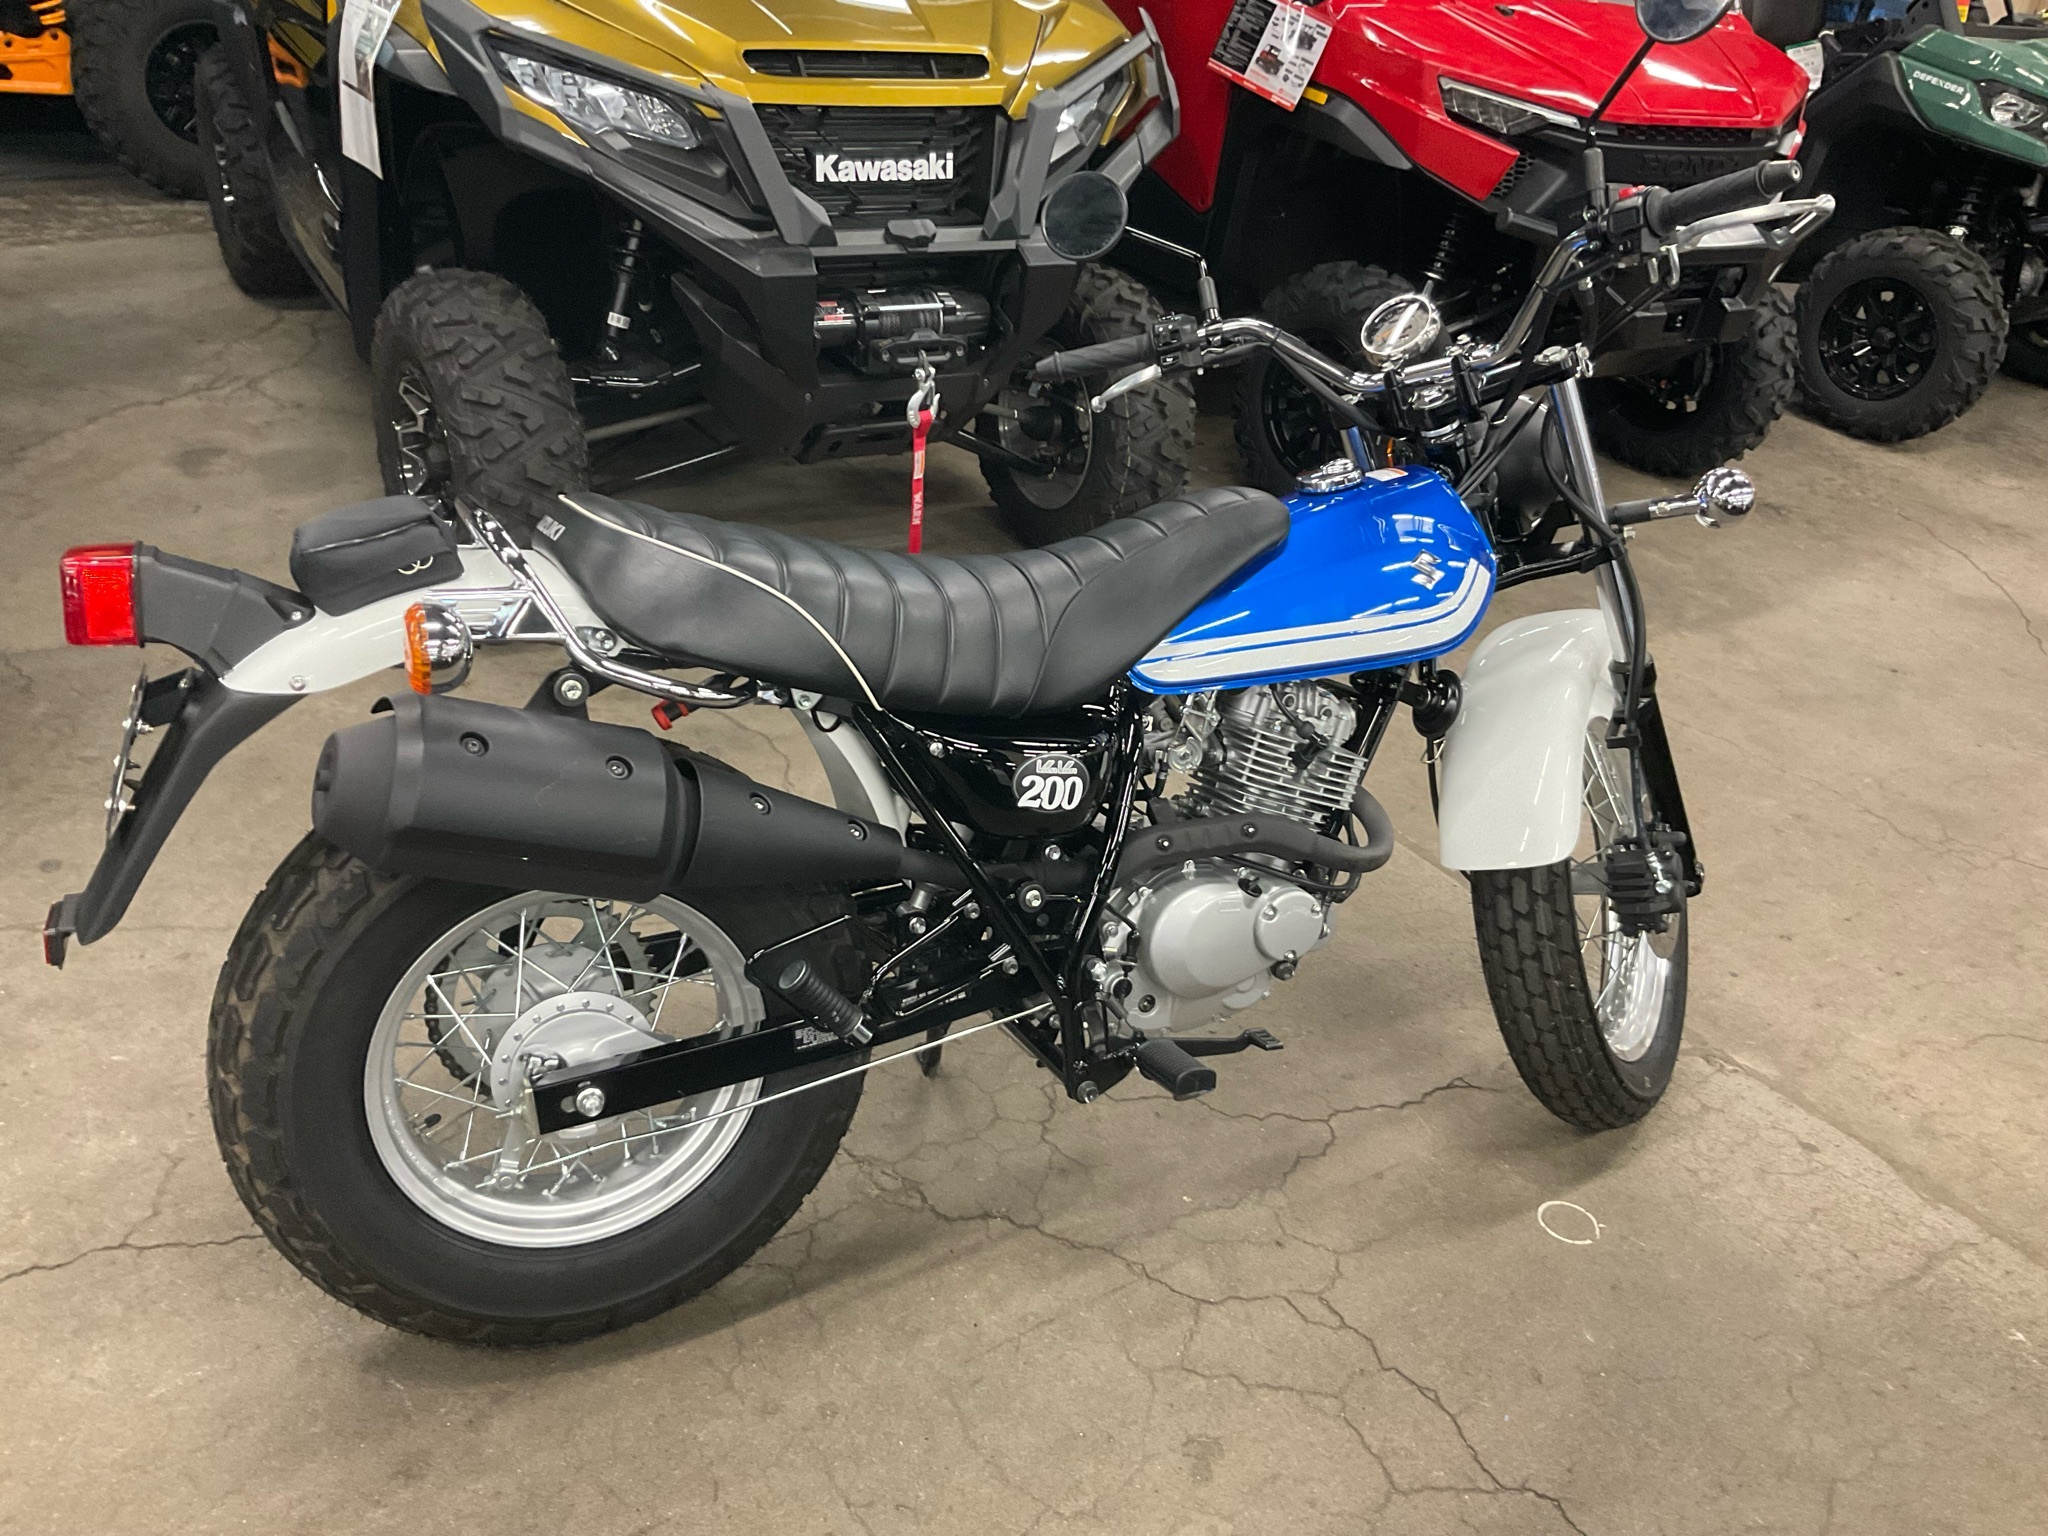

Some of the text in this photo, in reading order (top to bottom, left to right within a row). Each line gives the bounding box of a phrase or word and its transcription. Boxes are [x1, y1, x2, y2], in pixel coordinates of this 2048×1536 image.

[1913, 70, 1965, 95] DEFENDER
[815, 151, 954, 183] Kawasaki
[1017, 775, 1084, 811] 200
